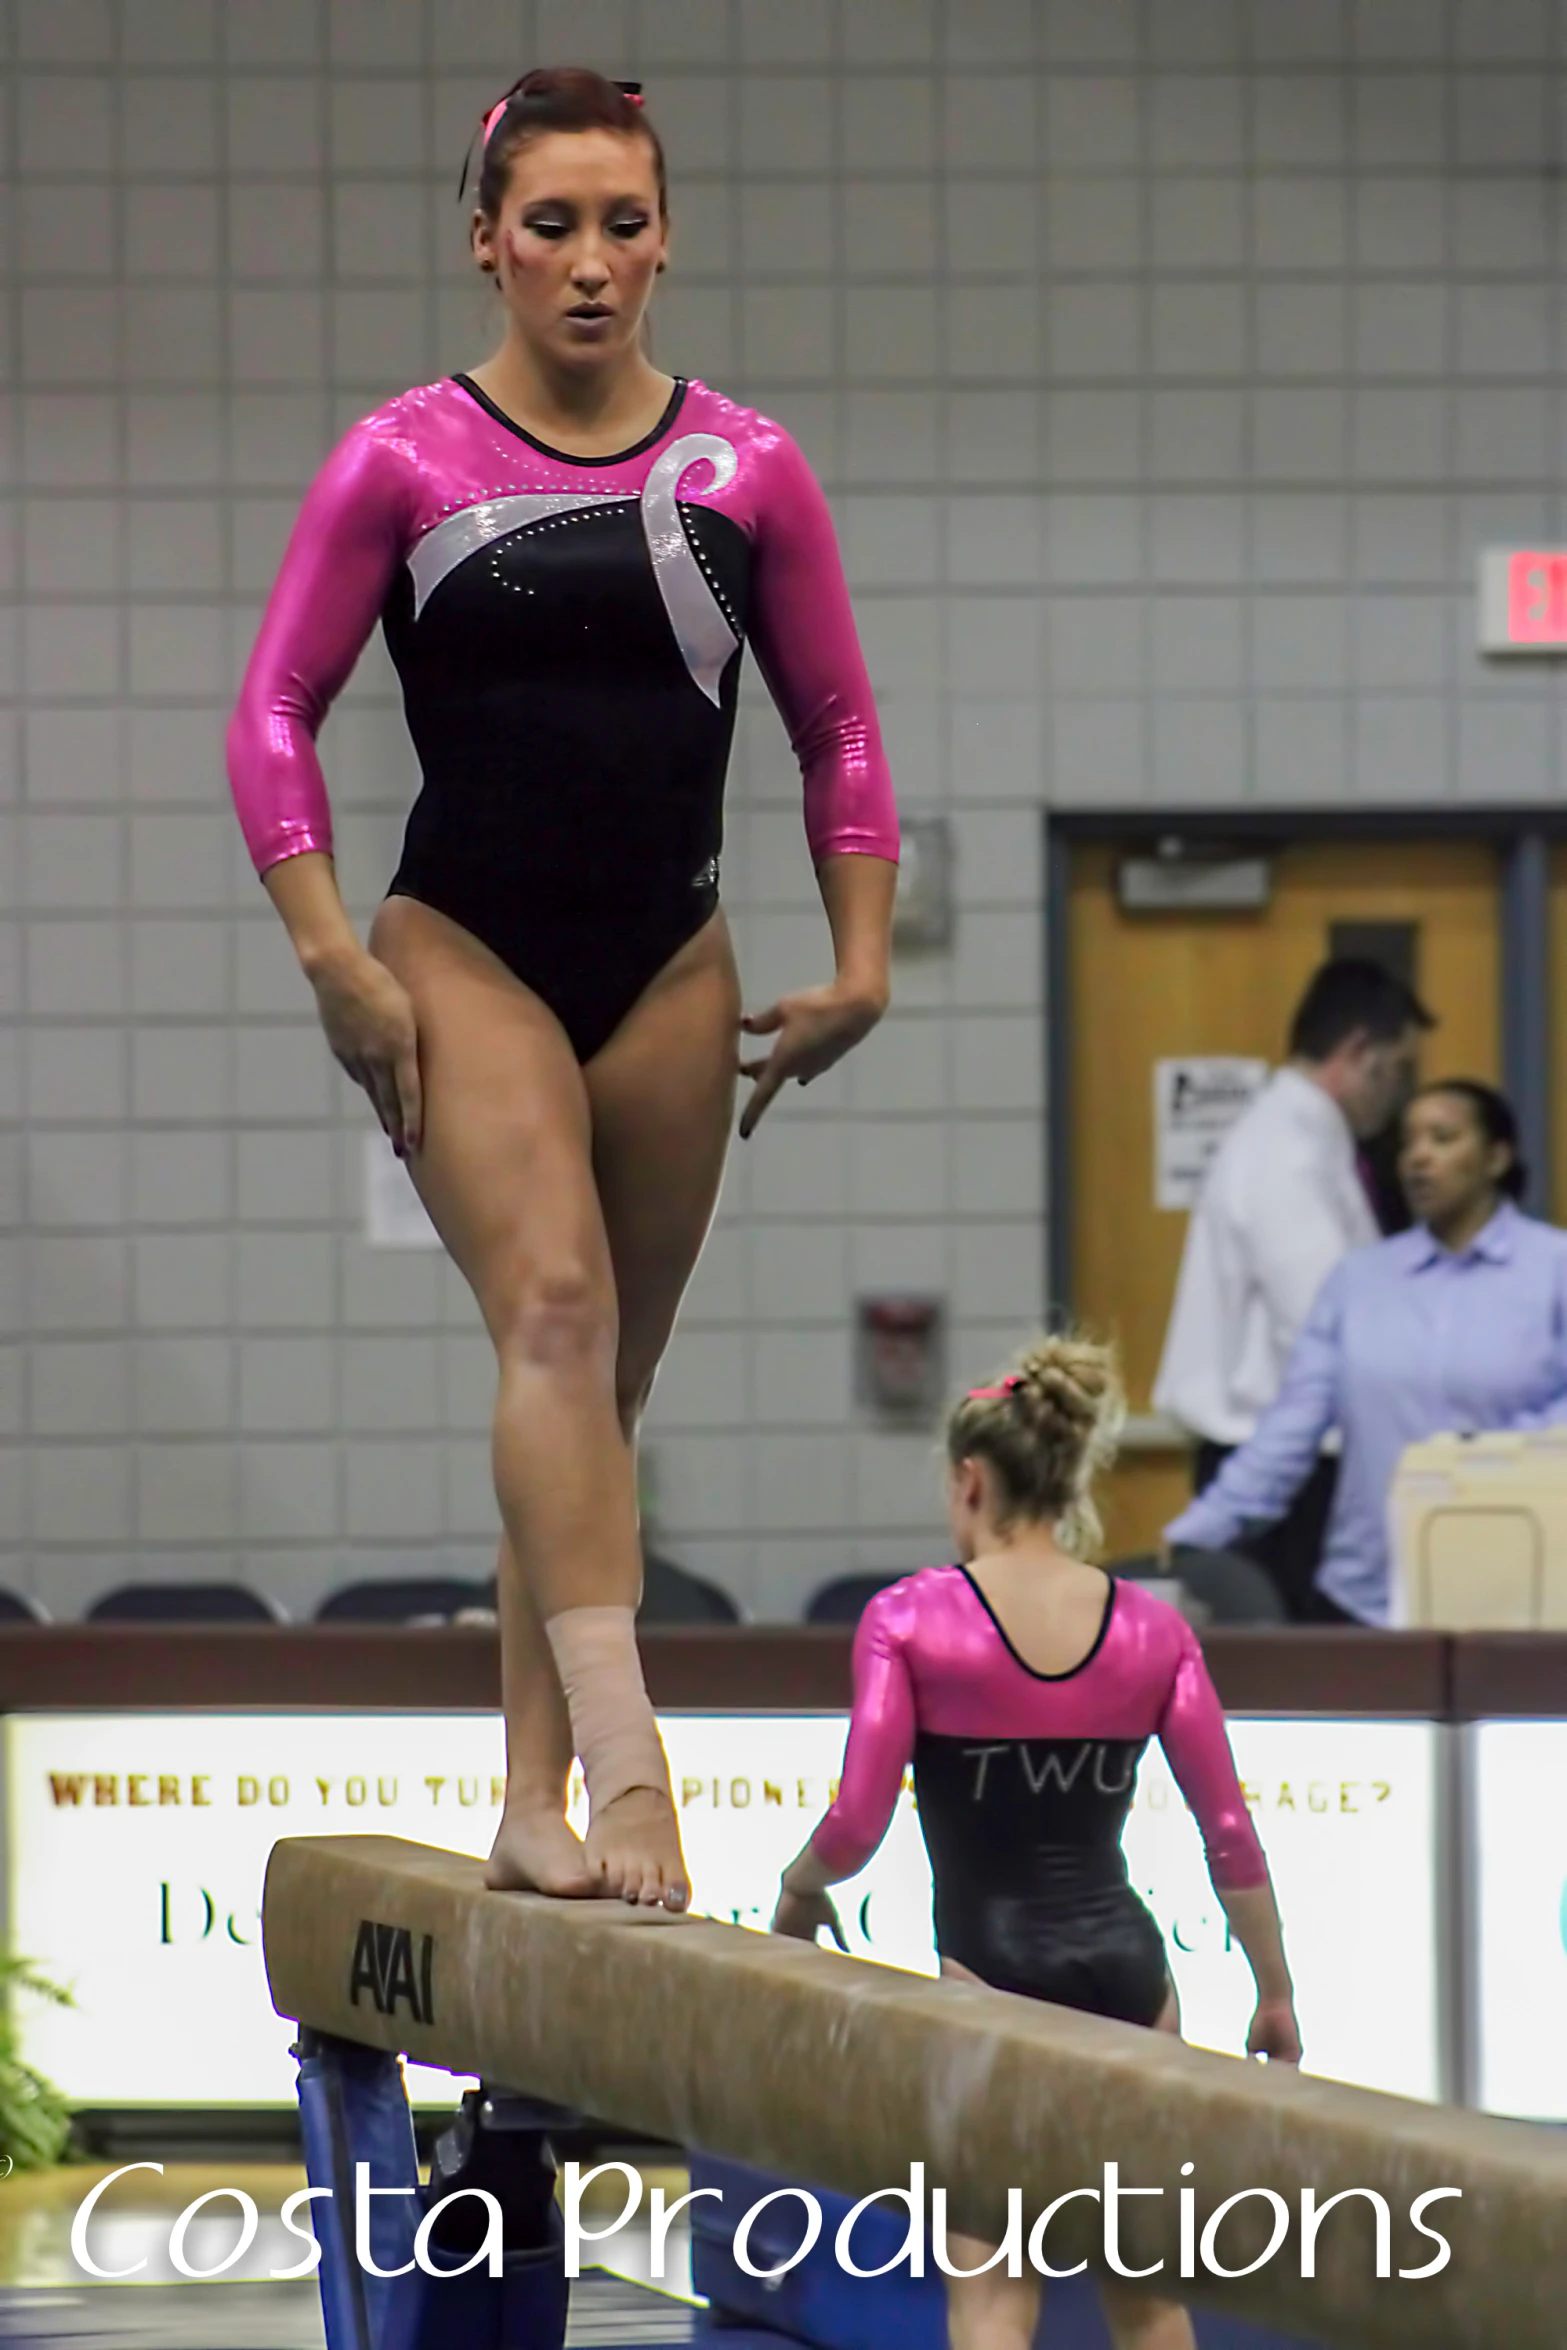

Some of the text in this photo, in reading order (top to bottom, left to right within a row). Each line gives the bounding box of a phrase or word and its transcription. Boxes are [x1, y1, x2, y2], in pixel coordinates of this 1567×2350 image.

[48, 1772, 211, 1807] WHERE
[237, 1774, 290, 1806] DO
[315, 1775, 398, 1807] YOU
[424, 1775, 507, 1807] TUR
[681, 1776, 841, 1809] PIONE
[962, 1743, 1137, 1801] TWU
